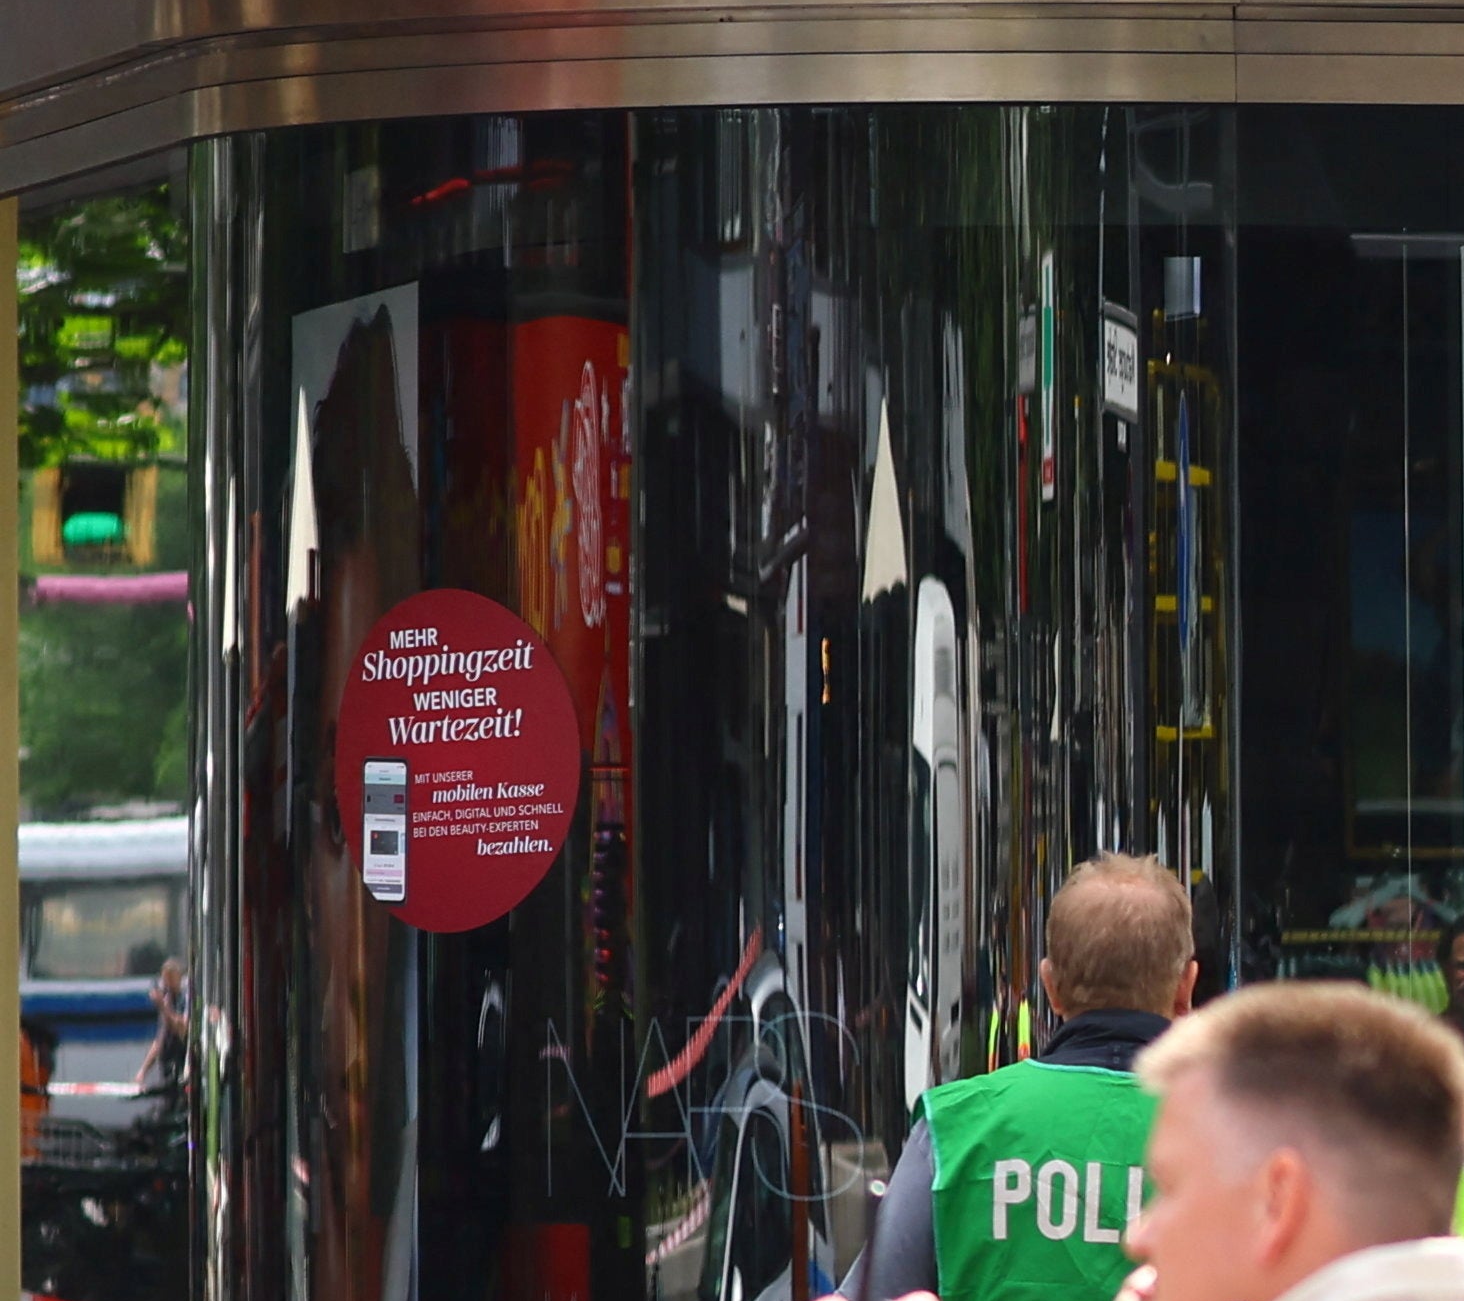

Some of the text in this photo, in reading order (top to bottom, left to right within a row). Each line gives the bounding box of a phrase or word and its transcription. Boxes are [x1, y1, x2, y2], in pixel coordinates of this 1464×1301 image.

[390, 627, 438, 650] MEHR
[362, 640, 534, 686] Shoppingzeit
[413, 687, 497, 711] WENIGER
[388, 708, 523, 746] Wartezeit!
[415, 770, 473, 784] MIT UNSERER
[432, 781, 544, 804] mobilen Kasse
[413, 803, 563, 824] EINFACH, DIGITAL UND SCHNELL
[413, 827, 427, 838] BEI
[429, 826, 448, 837] DEN
[477, 835, 553, 856] bezahlen.
[548, 1011, 865, 1201] NARS
[993, 1158, 1144, 1243] POLI
